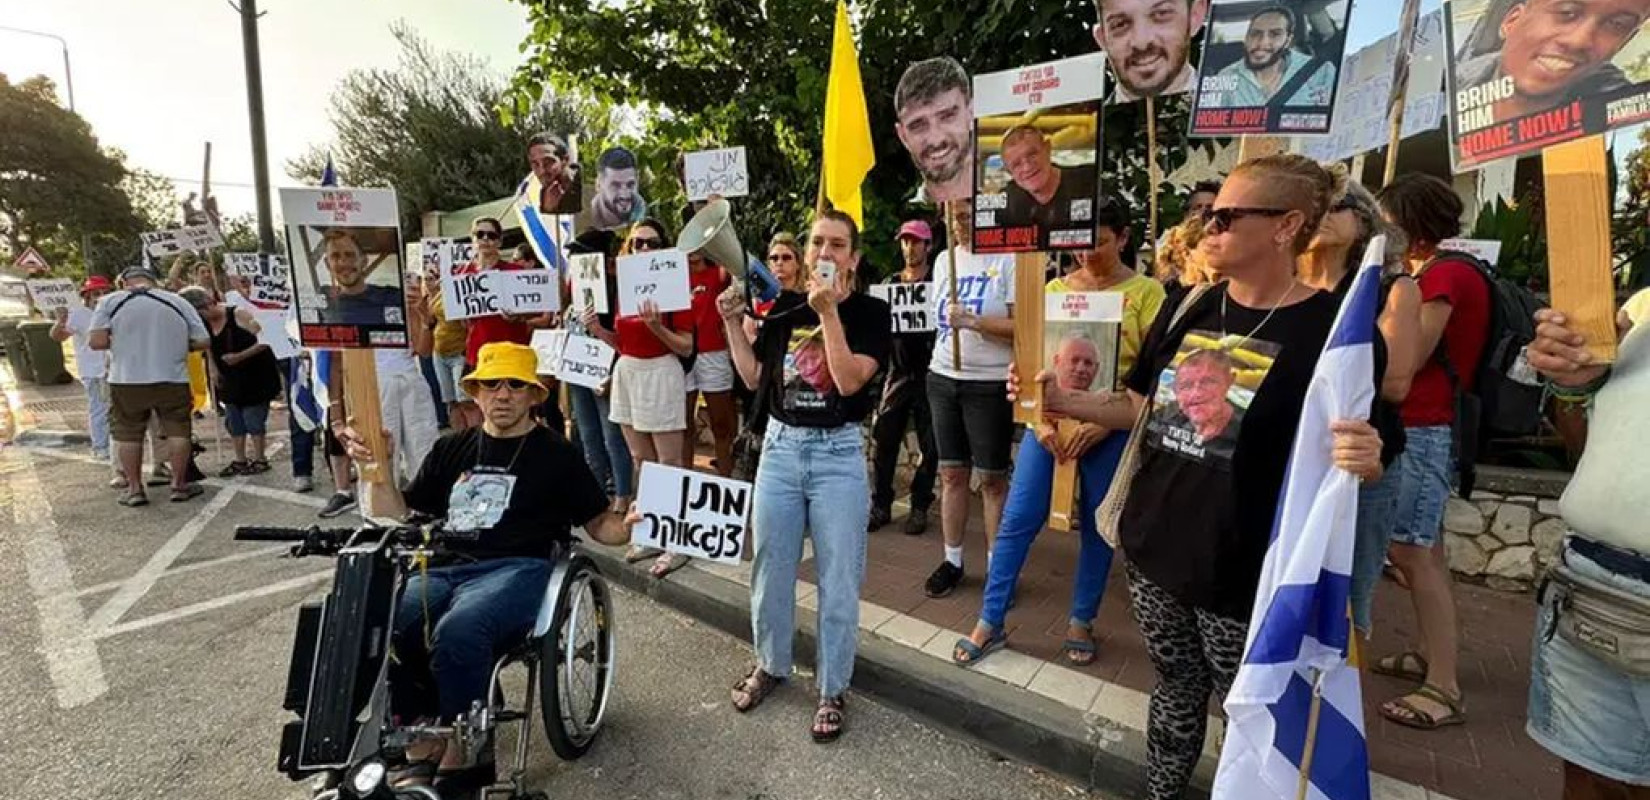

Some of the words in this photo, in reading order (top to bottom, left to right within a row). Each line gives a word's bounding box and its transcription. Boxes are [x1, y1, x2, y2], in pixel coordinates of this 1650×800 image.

[1201, 75, 1239, 91] BRING
[1457, 75, 1515, 111] BRING
[1195, 109, 1231, 127] HOME
[1231, 107, 1269, 126] NOW!
[1458, 104, 1494, 134] HIM
[1459, 123, 1514, 158] HOME
[1519, 98, 1582, 142] NOW!
[516, 275, 549, 285] עמרי
[513, 293, 542, 306] מירן
[888, 284, 926, 305] איתן
[678, 476, 747, 520] מתן
[643, 512, 742, 558] צנגאוקר
